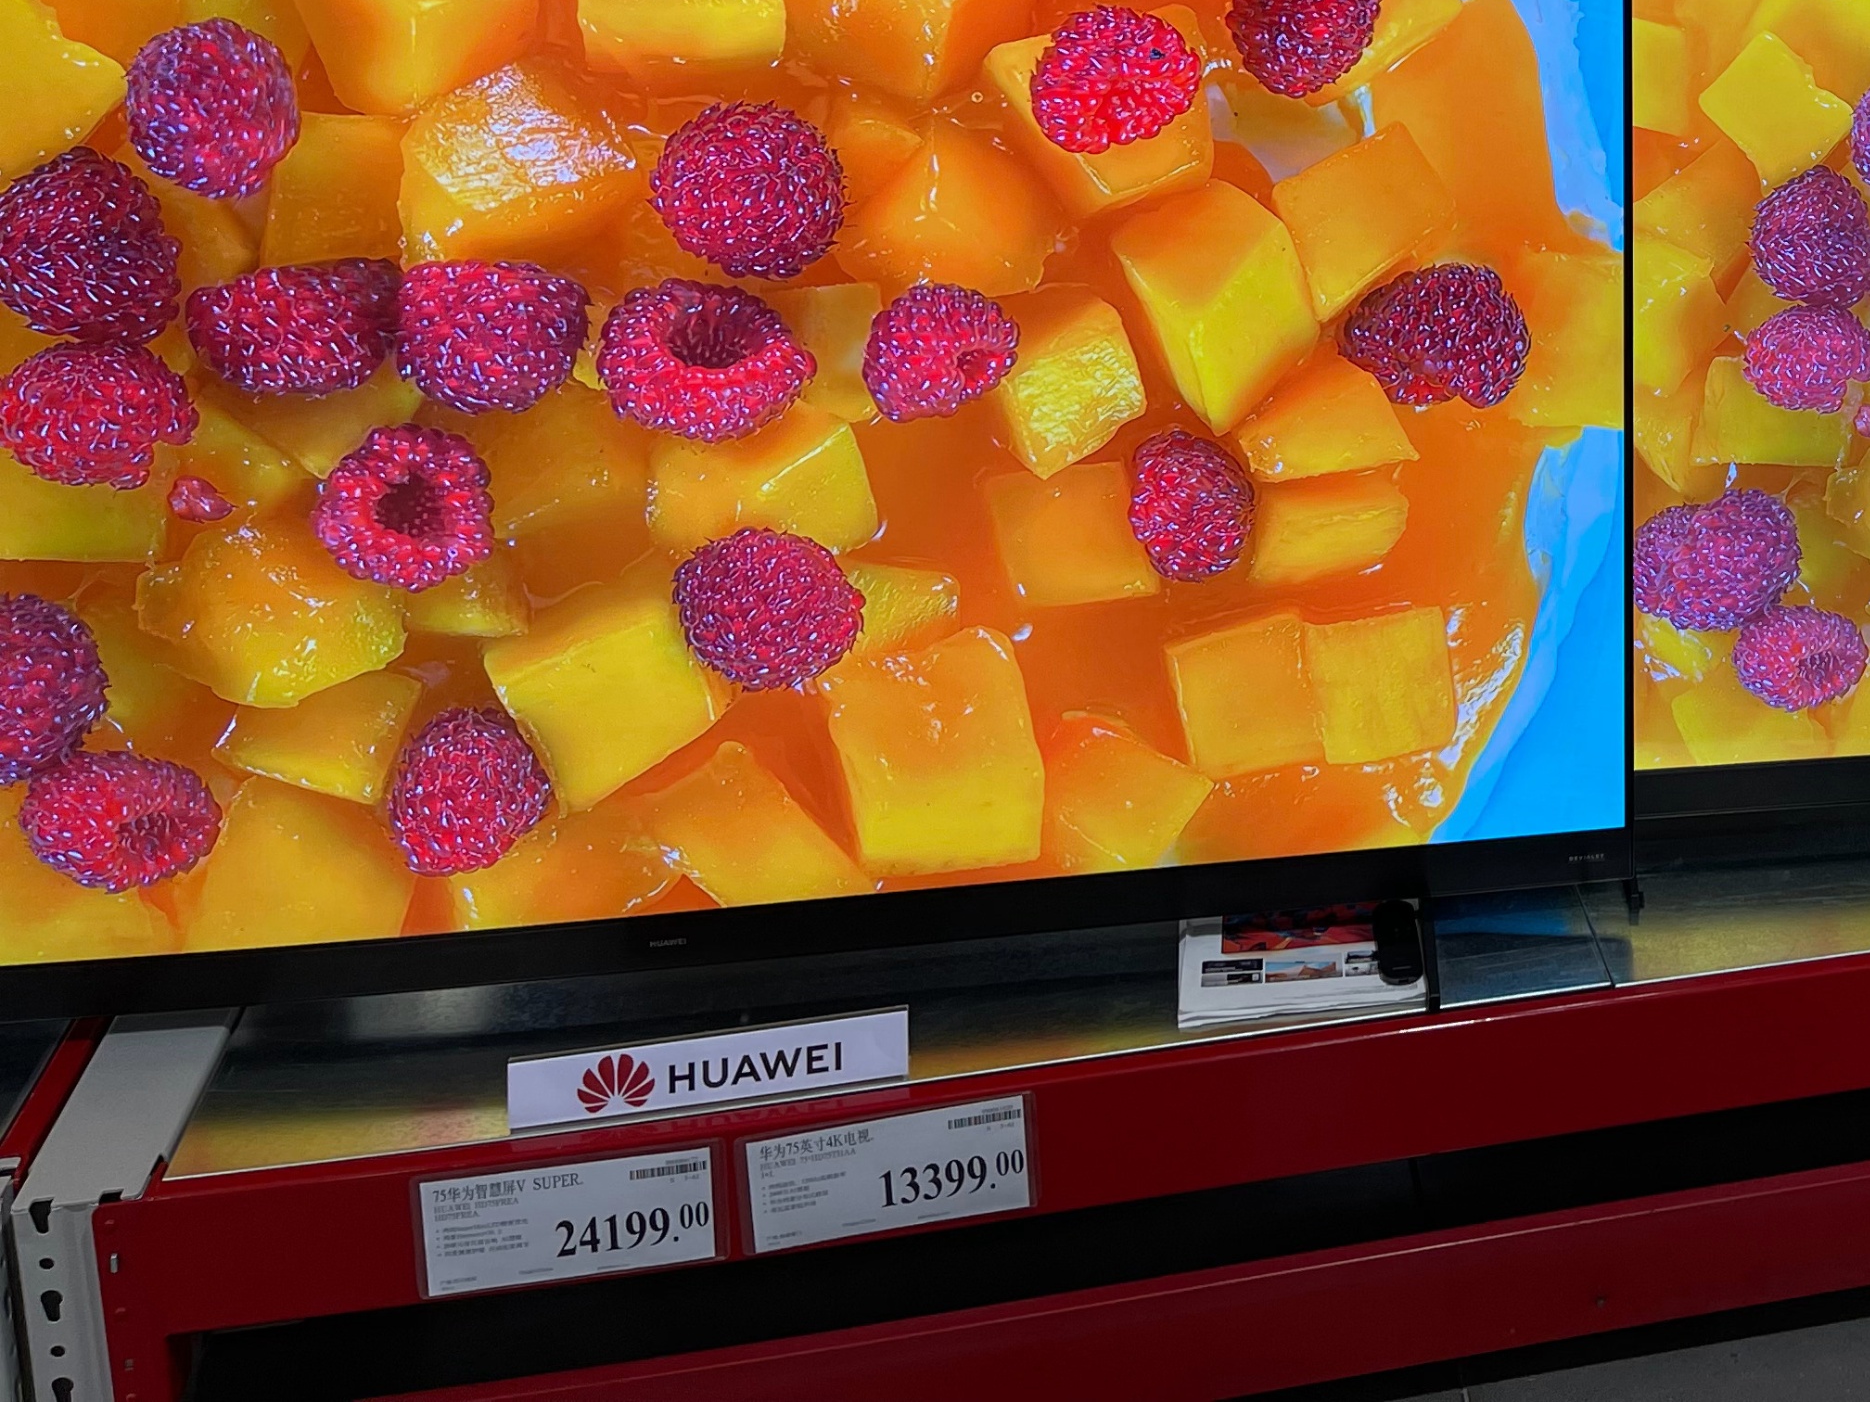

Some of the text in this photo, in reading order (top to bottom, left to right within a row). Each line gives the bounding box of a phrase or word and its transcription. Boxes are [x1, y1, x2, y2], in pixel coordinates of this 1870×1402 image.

[668, 1041, 842, 1094] HUAWEI
[879, 1149, 1024, 1208] 13399.00
[555, 1201, 709, 1258] 24199.00
